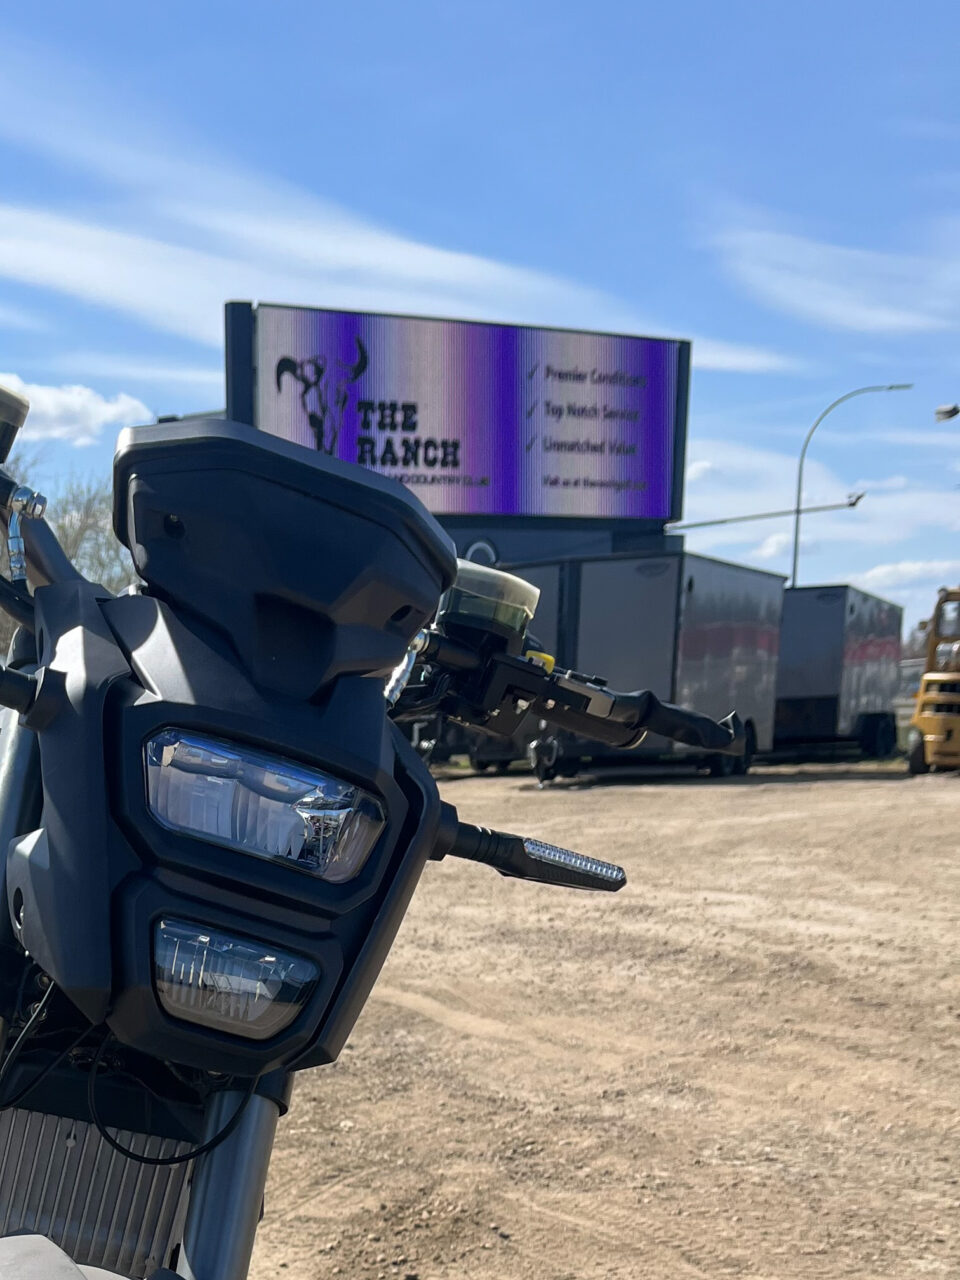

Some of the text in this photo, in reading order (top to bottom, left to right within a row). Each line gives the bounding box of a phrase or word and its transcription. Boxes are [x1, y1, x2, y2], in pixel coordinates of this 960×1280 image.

[544, 365, 587, 383] Premier
[357, 401, 417, 431] THE
[544, 400, 563, 422] Top
[566, 402, 599, 418] Notch
[357, 436, 460, 467] RANCH
[543, 436, 605, 453] Unmatched
